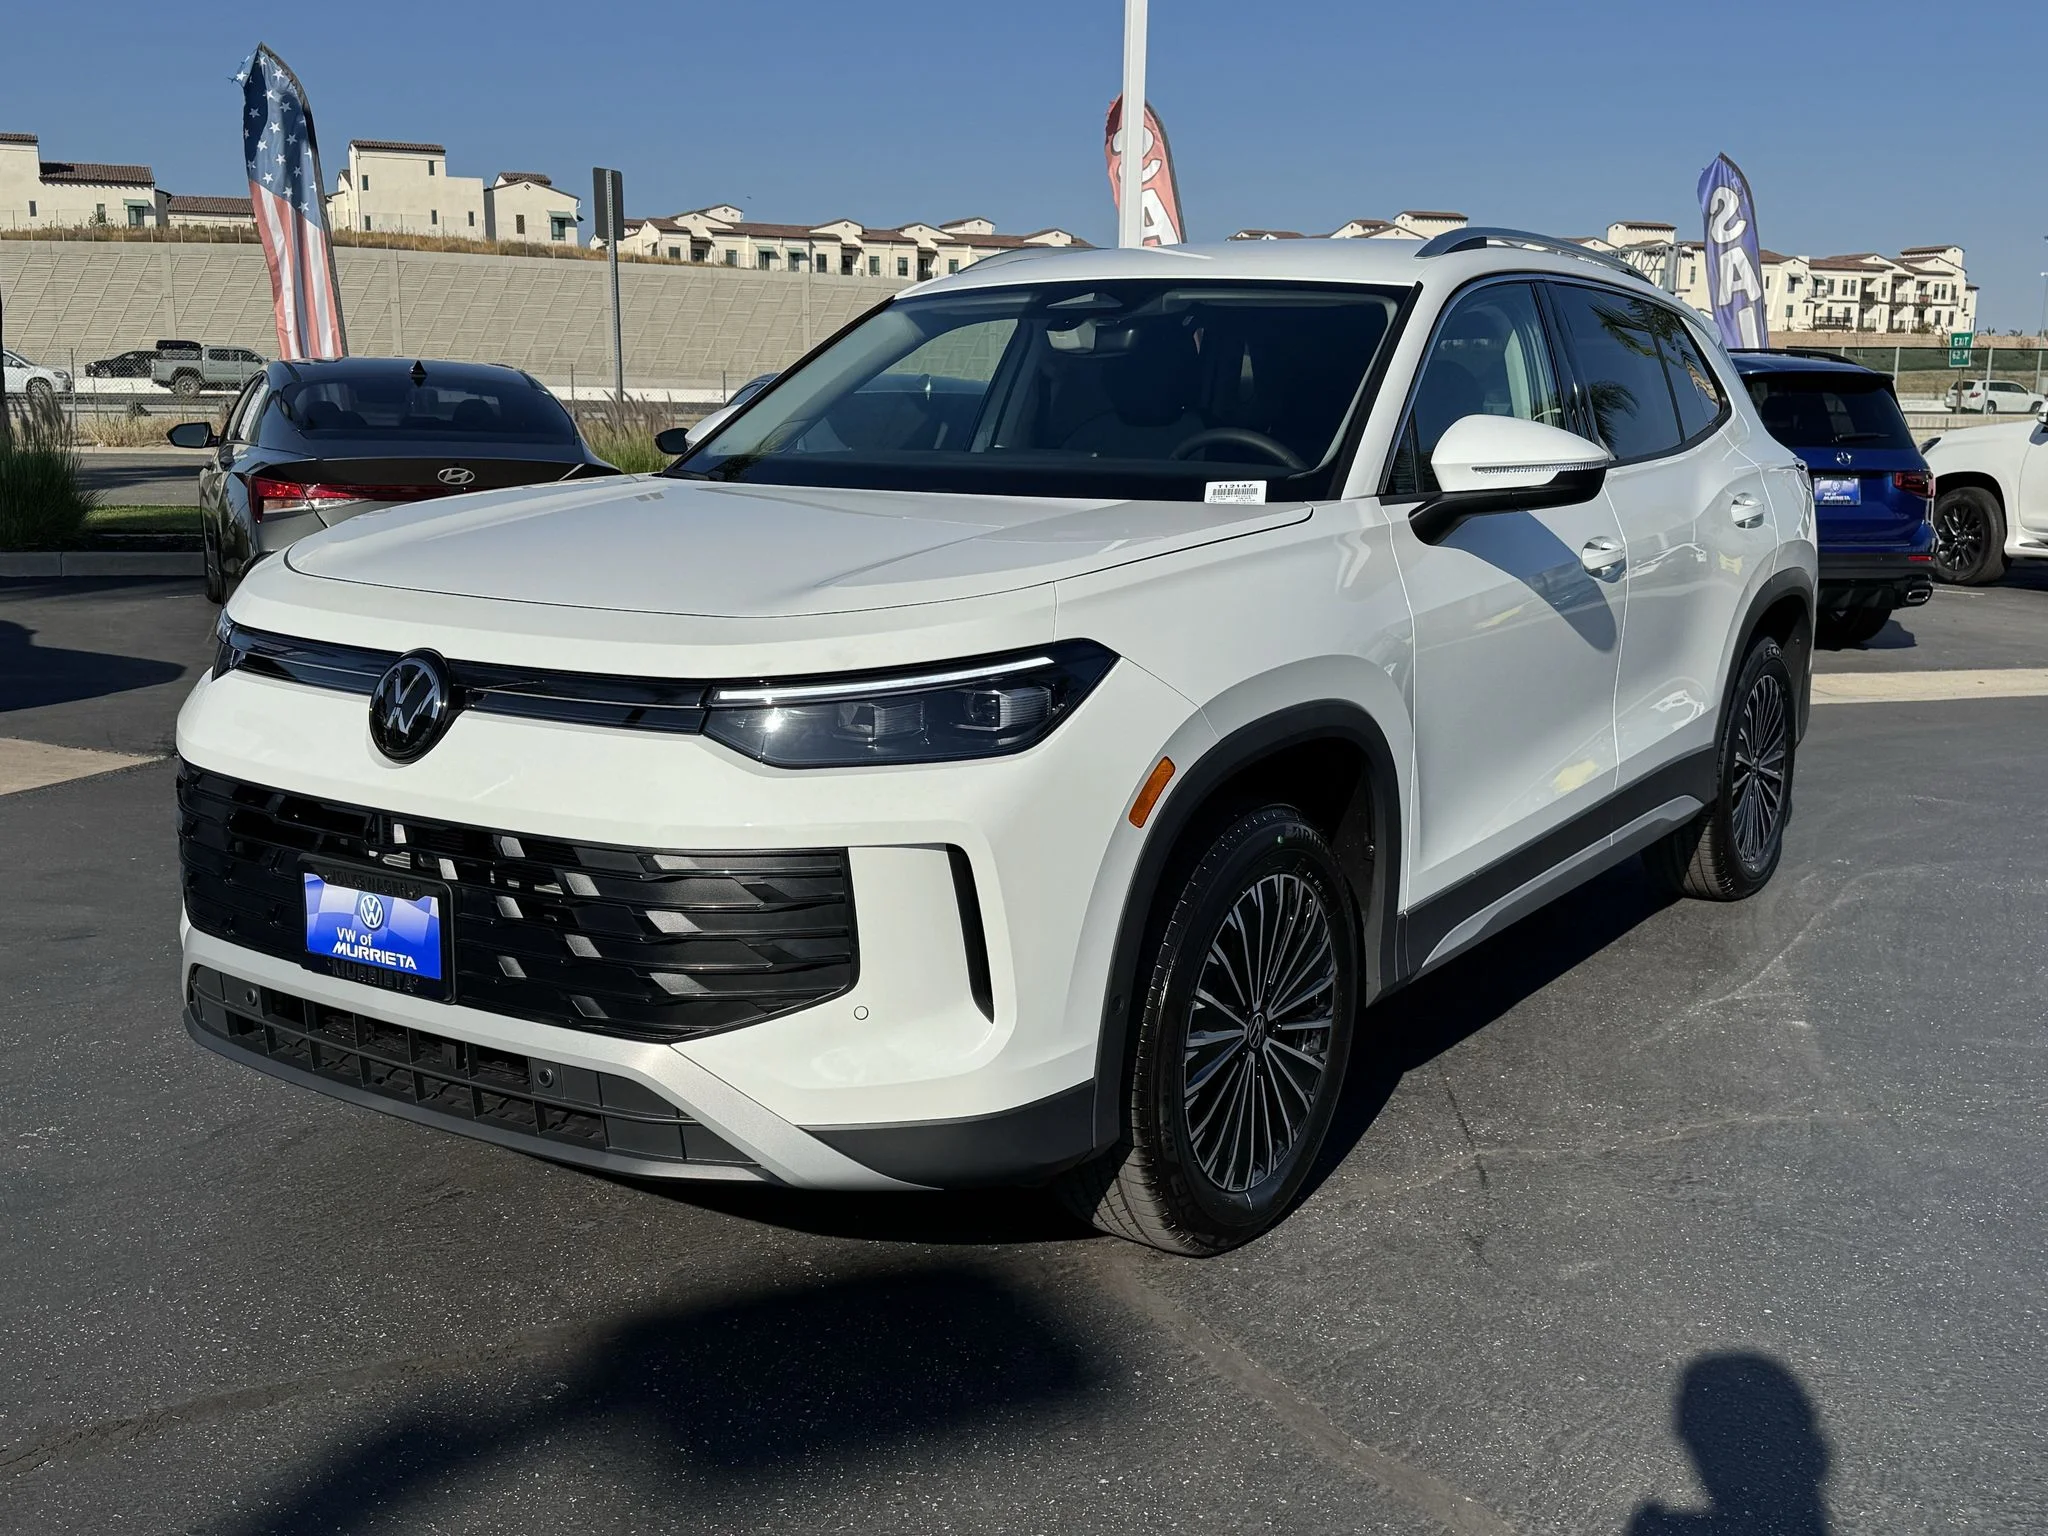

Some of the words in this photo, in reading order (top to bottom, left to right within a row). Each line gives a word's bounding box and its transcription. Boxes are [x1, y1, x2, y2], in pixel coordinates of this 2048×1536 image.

[1954, 336, 1970, 347] EXIT
[337, 927, 356, 942] VW
[360, 933, 373, 946] of
[333, 942, 417, 970] MURRIETA
